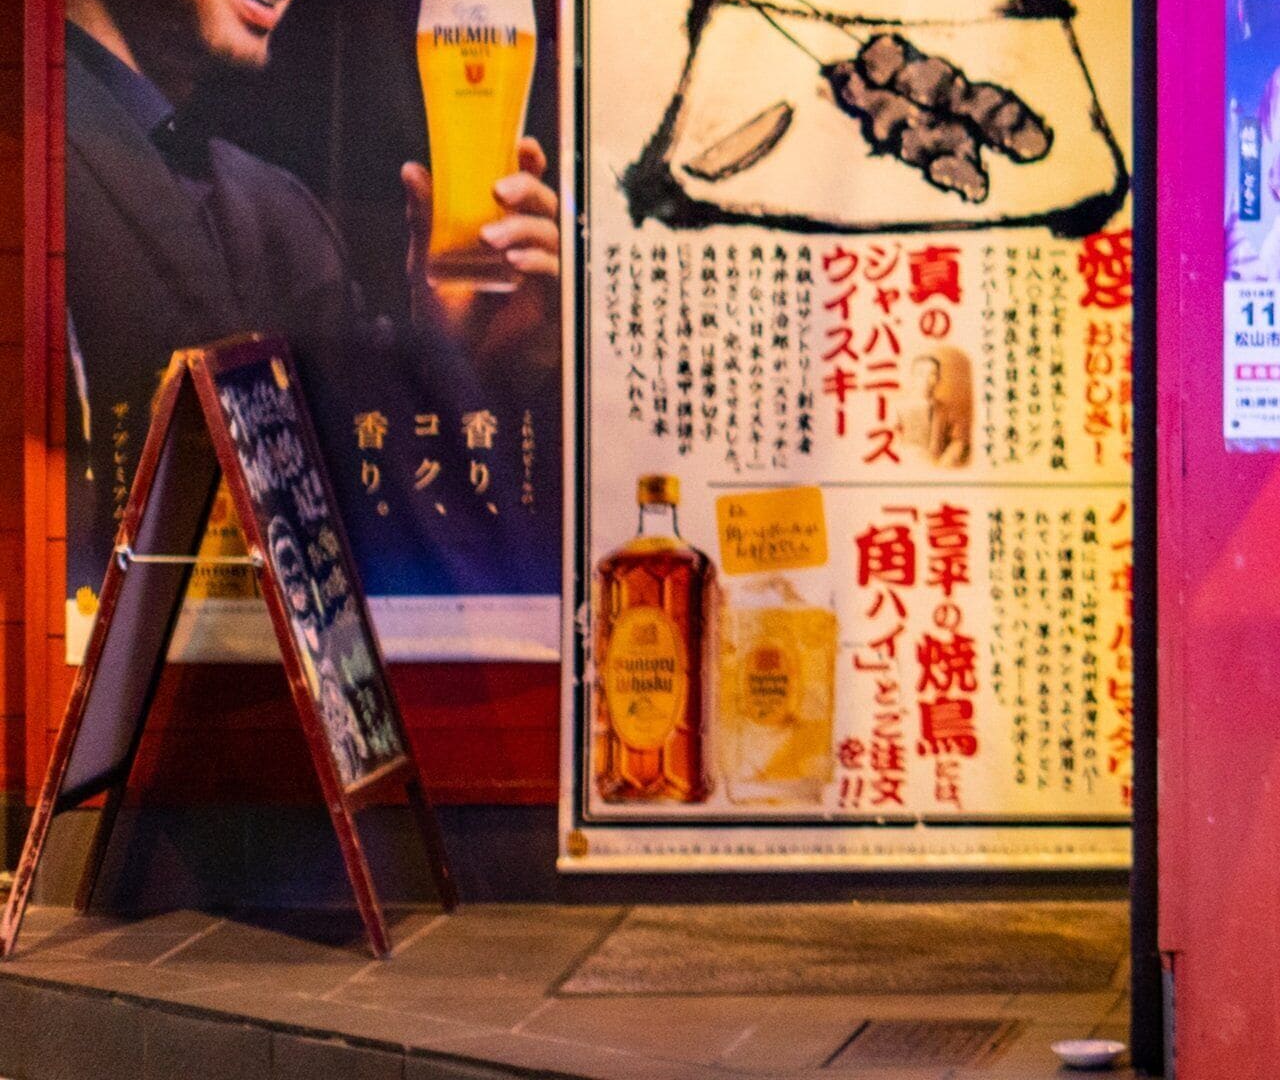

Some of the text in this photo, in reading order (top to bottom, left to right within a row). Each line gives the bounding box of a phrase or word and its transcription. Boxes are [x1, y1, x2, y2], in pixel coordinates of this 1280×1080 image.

[433, 25, 517, 48] PREMIUM
[822, 245, 860, 437] ウイスキー
[908, 245, 961, 339] 真の
[353, 410, 390, 517] 香り。
[415, 413, 448, 516] コク、
[462, 409, 499, 516] 香り、
[854, 505, 917, 806] 「角ハイ」とご注文
